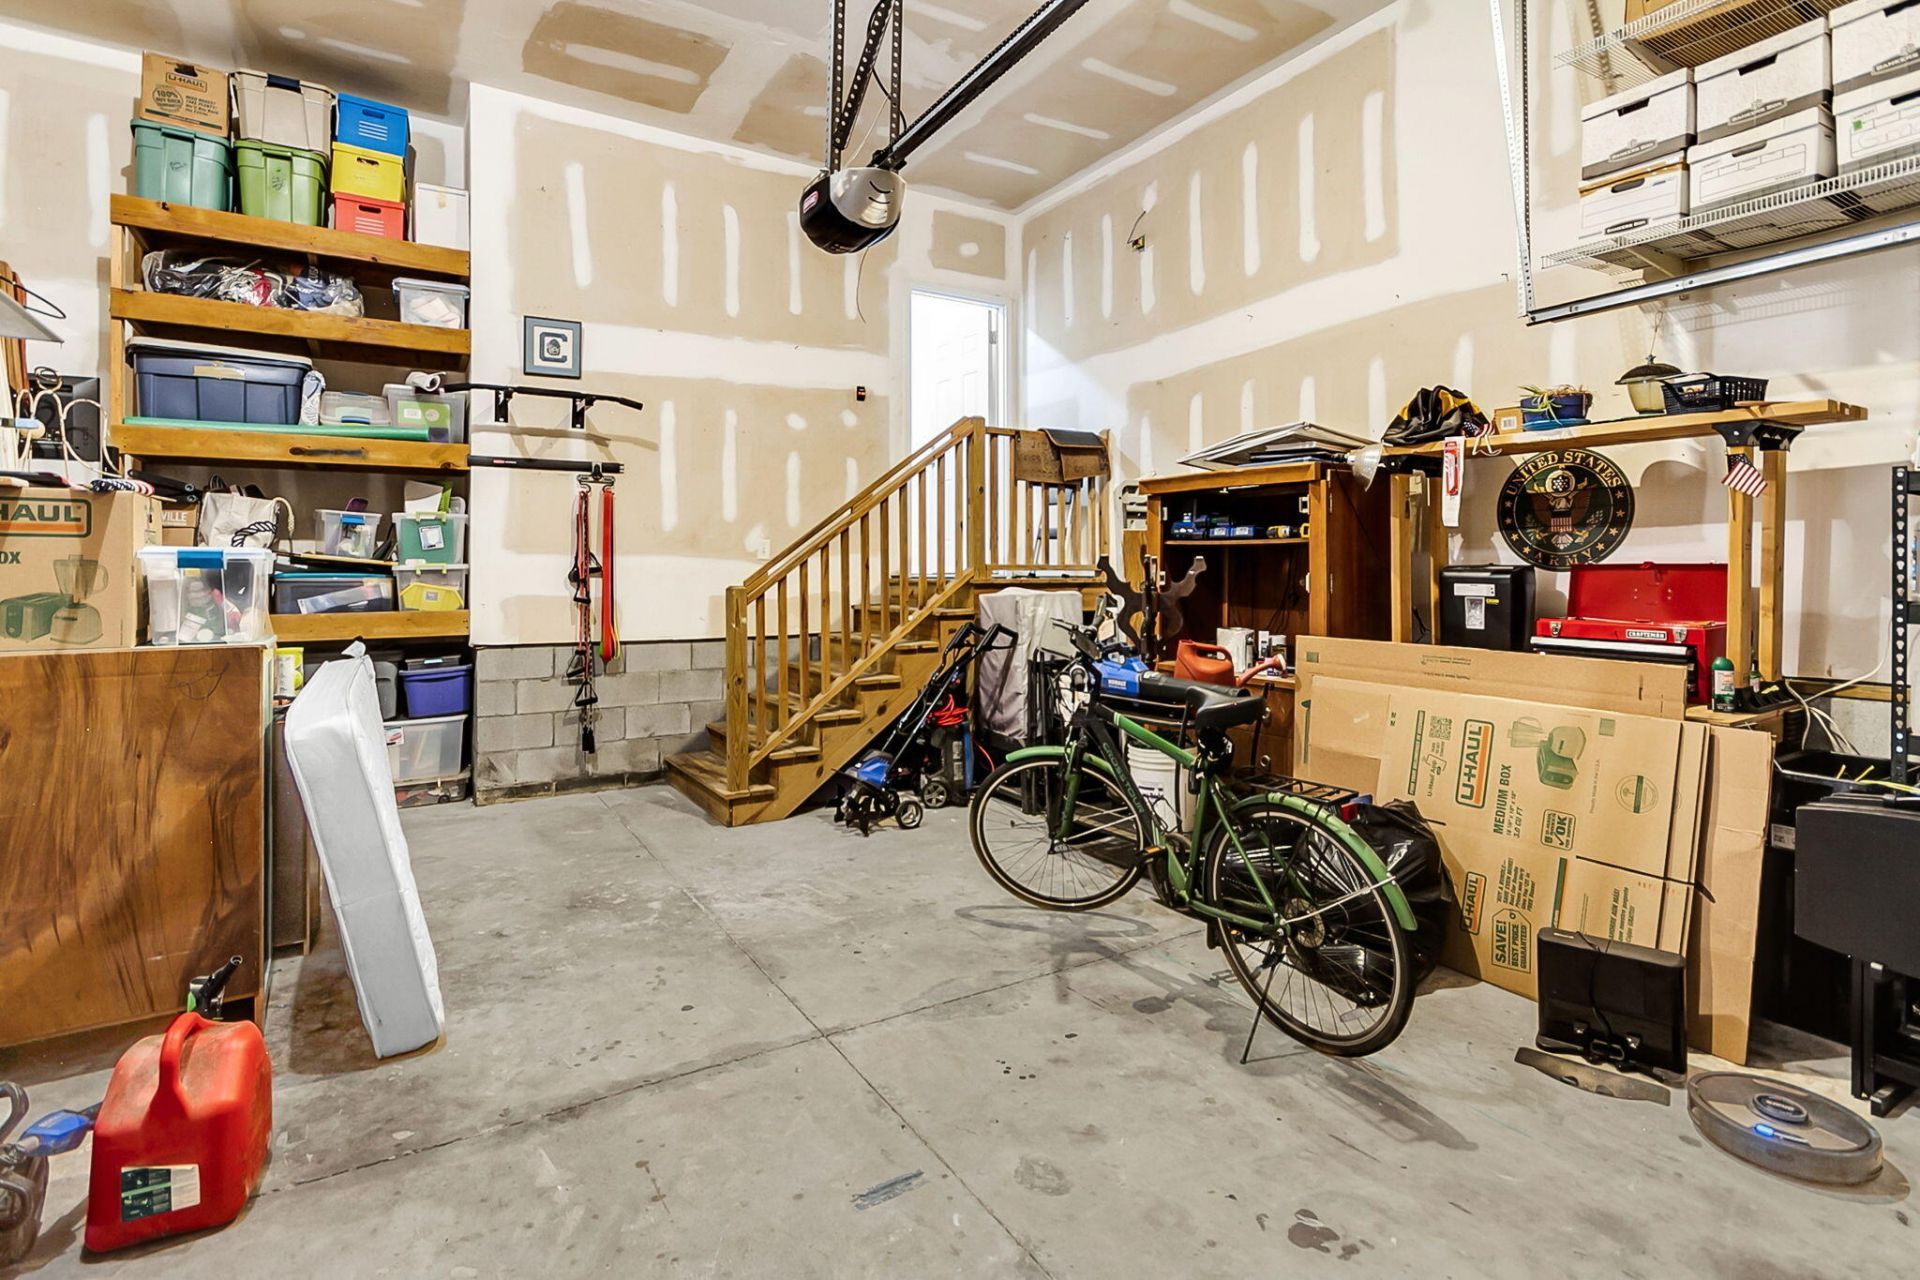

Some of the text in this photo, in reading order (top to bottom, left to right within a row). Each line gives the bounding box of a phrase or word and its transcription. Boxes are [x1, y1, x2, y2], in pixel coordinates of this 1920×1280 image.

[539, 332, 568, 363] C
[1506, 451, 1621, 496] UNITED STATES
[1534, 548, 1592, 566] ARMY
[1629, 631, 1665, 639] CRAFTSMAN
[1460, 725, 1481, 800] U-HAUL
[1493, 763, 1511, 834] MEDIUM BOX
[1555, 815, 1567, 835] OK
[1493, 919, 1508, 963] SAVE!
[1510, 923, 1519, 966] BEST PRICE
[1518, 924, 1528, 967] GUARANTEED
